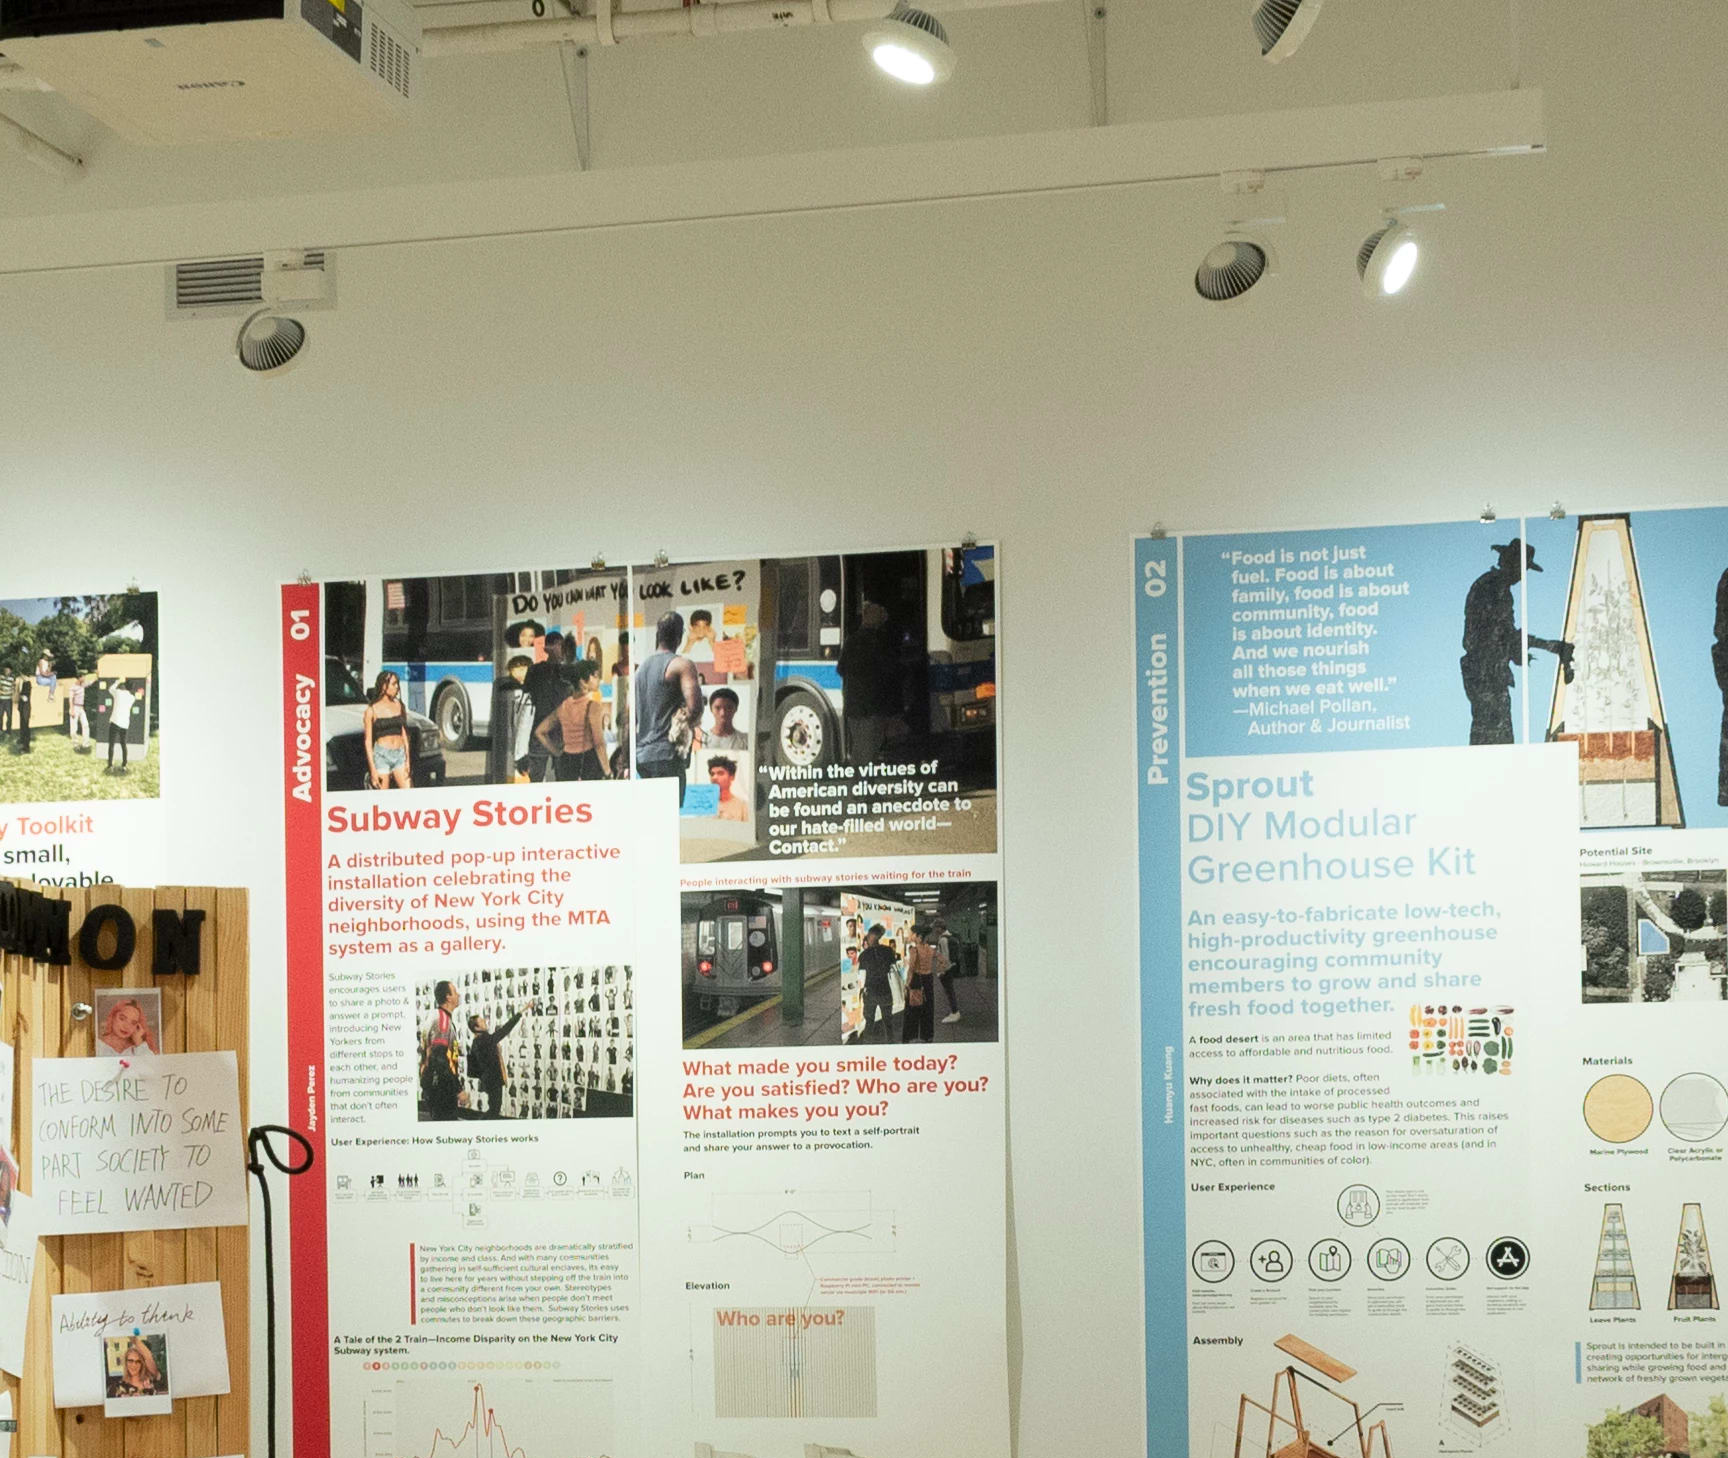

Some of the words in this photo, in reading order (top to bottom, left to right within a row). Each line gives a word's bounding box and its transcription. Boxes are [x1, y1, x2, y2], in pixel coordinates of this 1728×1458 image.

[1144, 559, 1166, 597] 02
[291, 609, 311, 640] 01
[1146, 632, 1169, 785] Prevention
[291, 673, 317, 804] Advocacy
[826, 761, 853, 778] the
[858, 761, 916, 778] virtues
[916, 760, 938, 776] of
[769, 782, 847, 800] American
[852, 778, 924, 800] diversity
[929, 780, 959, 794] can
[1186, 770, 1314, 807] Sprout
[328, 803, 465, 838] Subway
[472, 796, 594, 830] Stories
[769, 801, 789, 818] be
[794, 800, 842, 817] found
[846, 802, 866, 816] an
[870, 798, 949, 814] anecdote
[953, 798, 971, 812] to
[18, 814, 94, 836] Toolkit
[769, 822, 797, 836] our
[801, 817, 885, 835] hate-filled
[1188, 812, 1251, 843] DIY
[1265, 808, 1416, 841] Modular
[4, 844, 70, 864] small,
[328, 851, 342, 869] A
[346, 848, 446, 869] distributed
[451, 849, 515, 870] pop-up
[520, 843, 622, 865] interactive
[1580, 847, 1629, 857] Potential
[1632, 846, 1653, 855] Site
[1188, 853, 1414, 885] Greenhouse
[1428, 847, 1476, 876] Kit
[328, 872, 426, 891] installation
[431, 868, 534, 892] celebrating
[540, 866, 571, 884] the
[683, 1061, 732, 1077] What
[737, 1058, 790, 1074] made
[796, 1061, 830, 1077] you
[836, 1056, 887, 1073] smile
[894, 1054, 958, 1074] today?
[1582, 1056, 1633, 1066] Materials
[39, 1081, 71, 1106] THE
[81, 1077, 150, 1104] DESIRE
[162, 1073, 188, 1096] TO
[683, 1083, 716, 1099] Are
[721, 1084, 754, 1101] you
[761, 1079, 850, 1096] satisfied?
[856, 1078, 901, 1095] Who
[907, 1080, 937, 1094] are
[944, 1077, 989, 1096] you?
[683, 1104, 732, 1121] What
[738, 1103, 798, 1119] makes
[805, 1105, 839, 1122] you
[846, 1101, 889, 1121] you?
[39, 1115, 116, 1142] CONFORM
[130, 1110, 172, 1136] INTO
[181, 1108, 230, 1135] SOME
[331, 1138, 353, 1147] User
[355, 1136, 410, 1148] Experience:
[412, 1136, 433, 1145] How
[436, 1135, 473, 1146] Subway
[476, 1134, 508, 1144] Stories
[511, 1134, 539, 1143] works
[41, 1153, 81, 1179] PART
[97, 1149, 170, 1175] SOCIETY
[184, 1144, 212, 1167] TO
[684, 1171, 704, 1180] Plan
[1191, 1182, 1214, 1192] User
[1218, 1181, 1275, 1193] Experience
[1584, 1182, 1631, 1192] Sections
[59, 1189, 109, 1216] FEEL
[125, 1181, 213, 1212] WANTED
[685, 1282, 730, 1290] Elevation
[1193, 1335, 1244, 1347] Assembly
